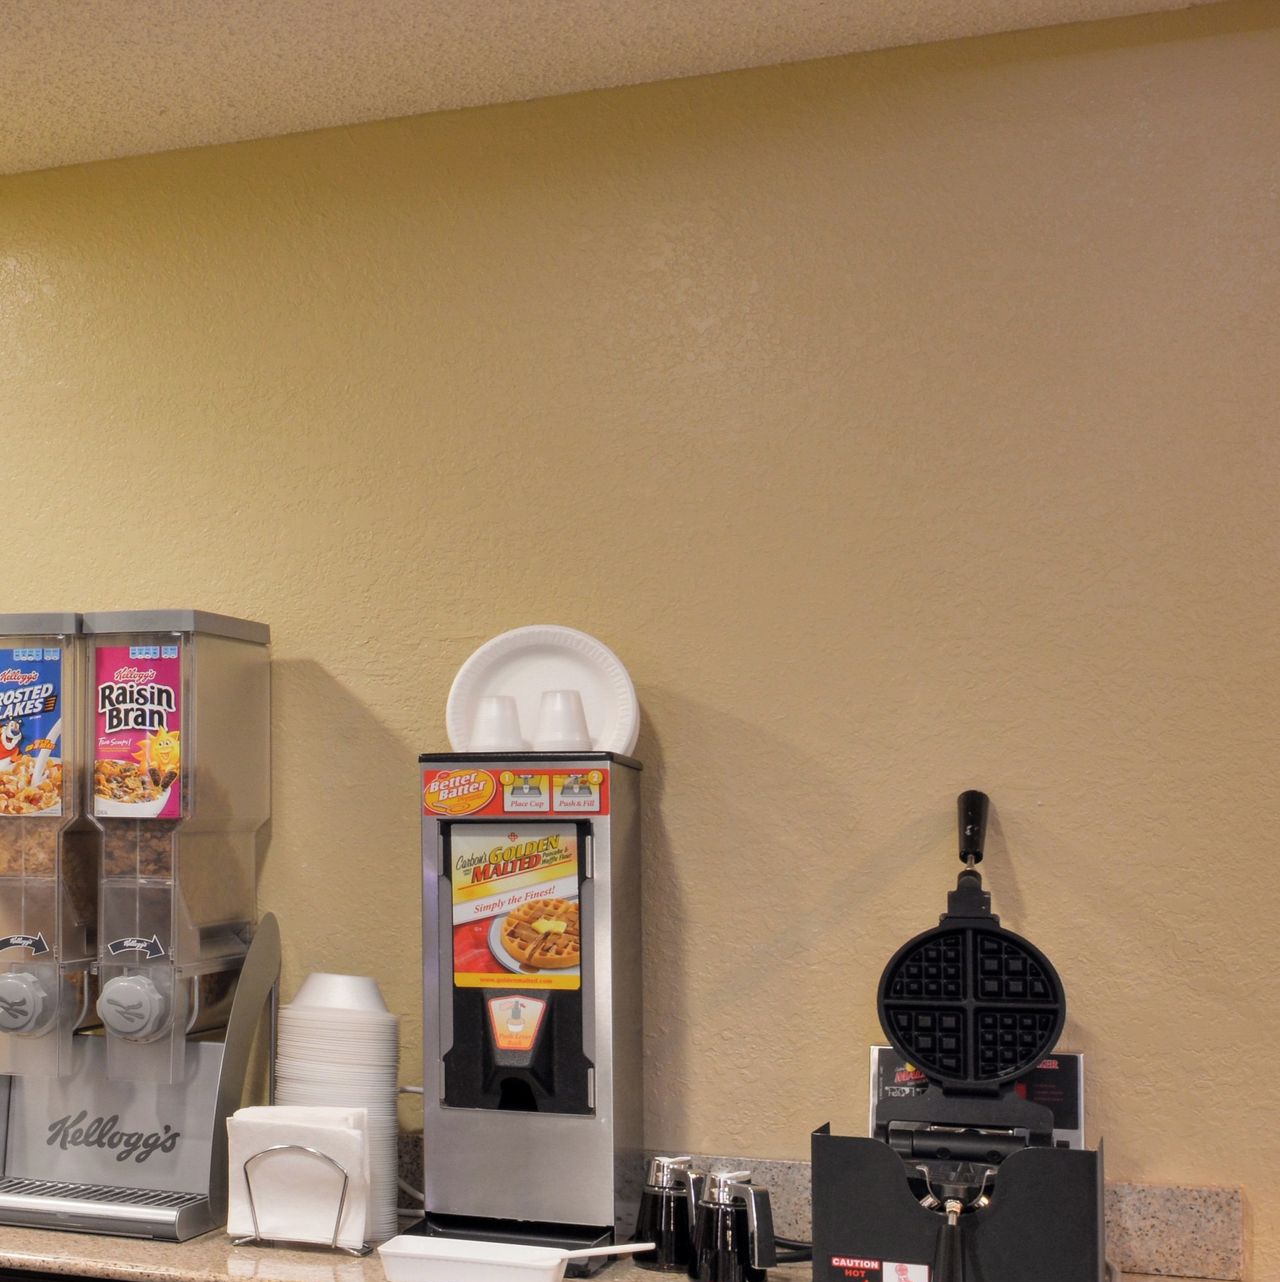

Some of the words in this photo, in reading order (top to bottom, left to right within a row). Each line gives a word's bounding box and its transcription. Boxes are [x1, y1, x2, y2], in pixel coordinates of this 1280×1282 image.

[0, 668, 39, 685] Kellogg's
[114, 666, 156, 683] Kellogg's
[99, 683, 175, 711] Raisin
[107, 706, 166, 730] Bran
[429, 771, 478, 793] Better
[439, 780, 487, 801] Batter
[510, 800, 528, 808] Place
[529, 800, 544, 809] Cup
[488, 834, 560, 864] GOLDEN
[456, 852, 487, 870] Carbon's
[471, 853, 542, 883] MALTED
[474, 899, 506, 914] Simply
[507, 895, 522, 905] the
[524, 885, 556, 901] Finest!
[46, 1110, 180, 1163] Kellogg's
[832, 1257, 880, 1269] CAUTION
[845, 1268, 866, 1278] HOT
